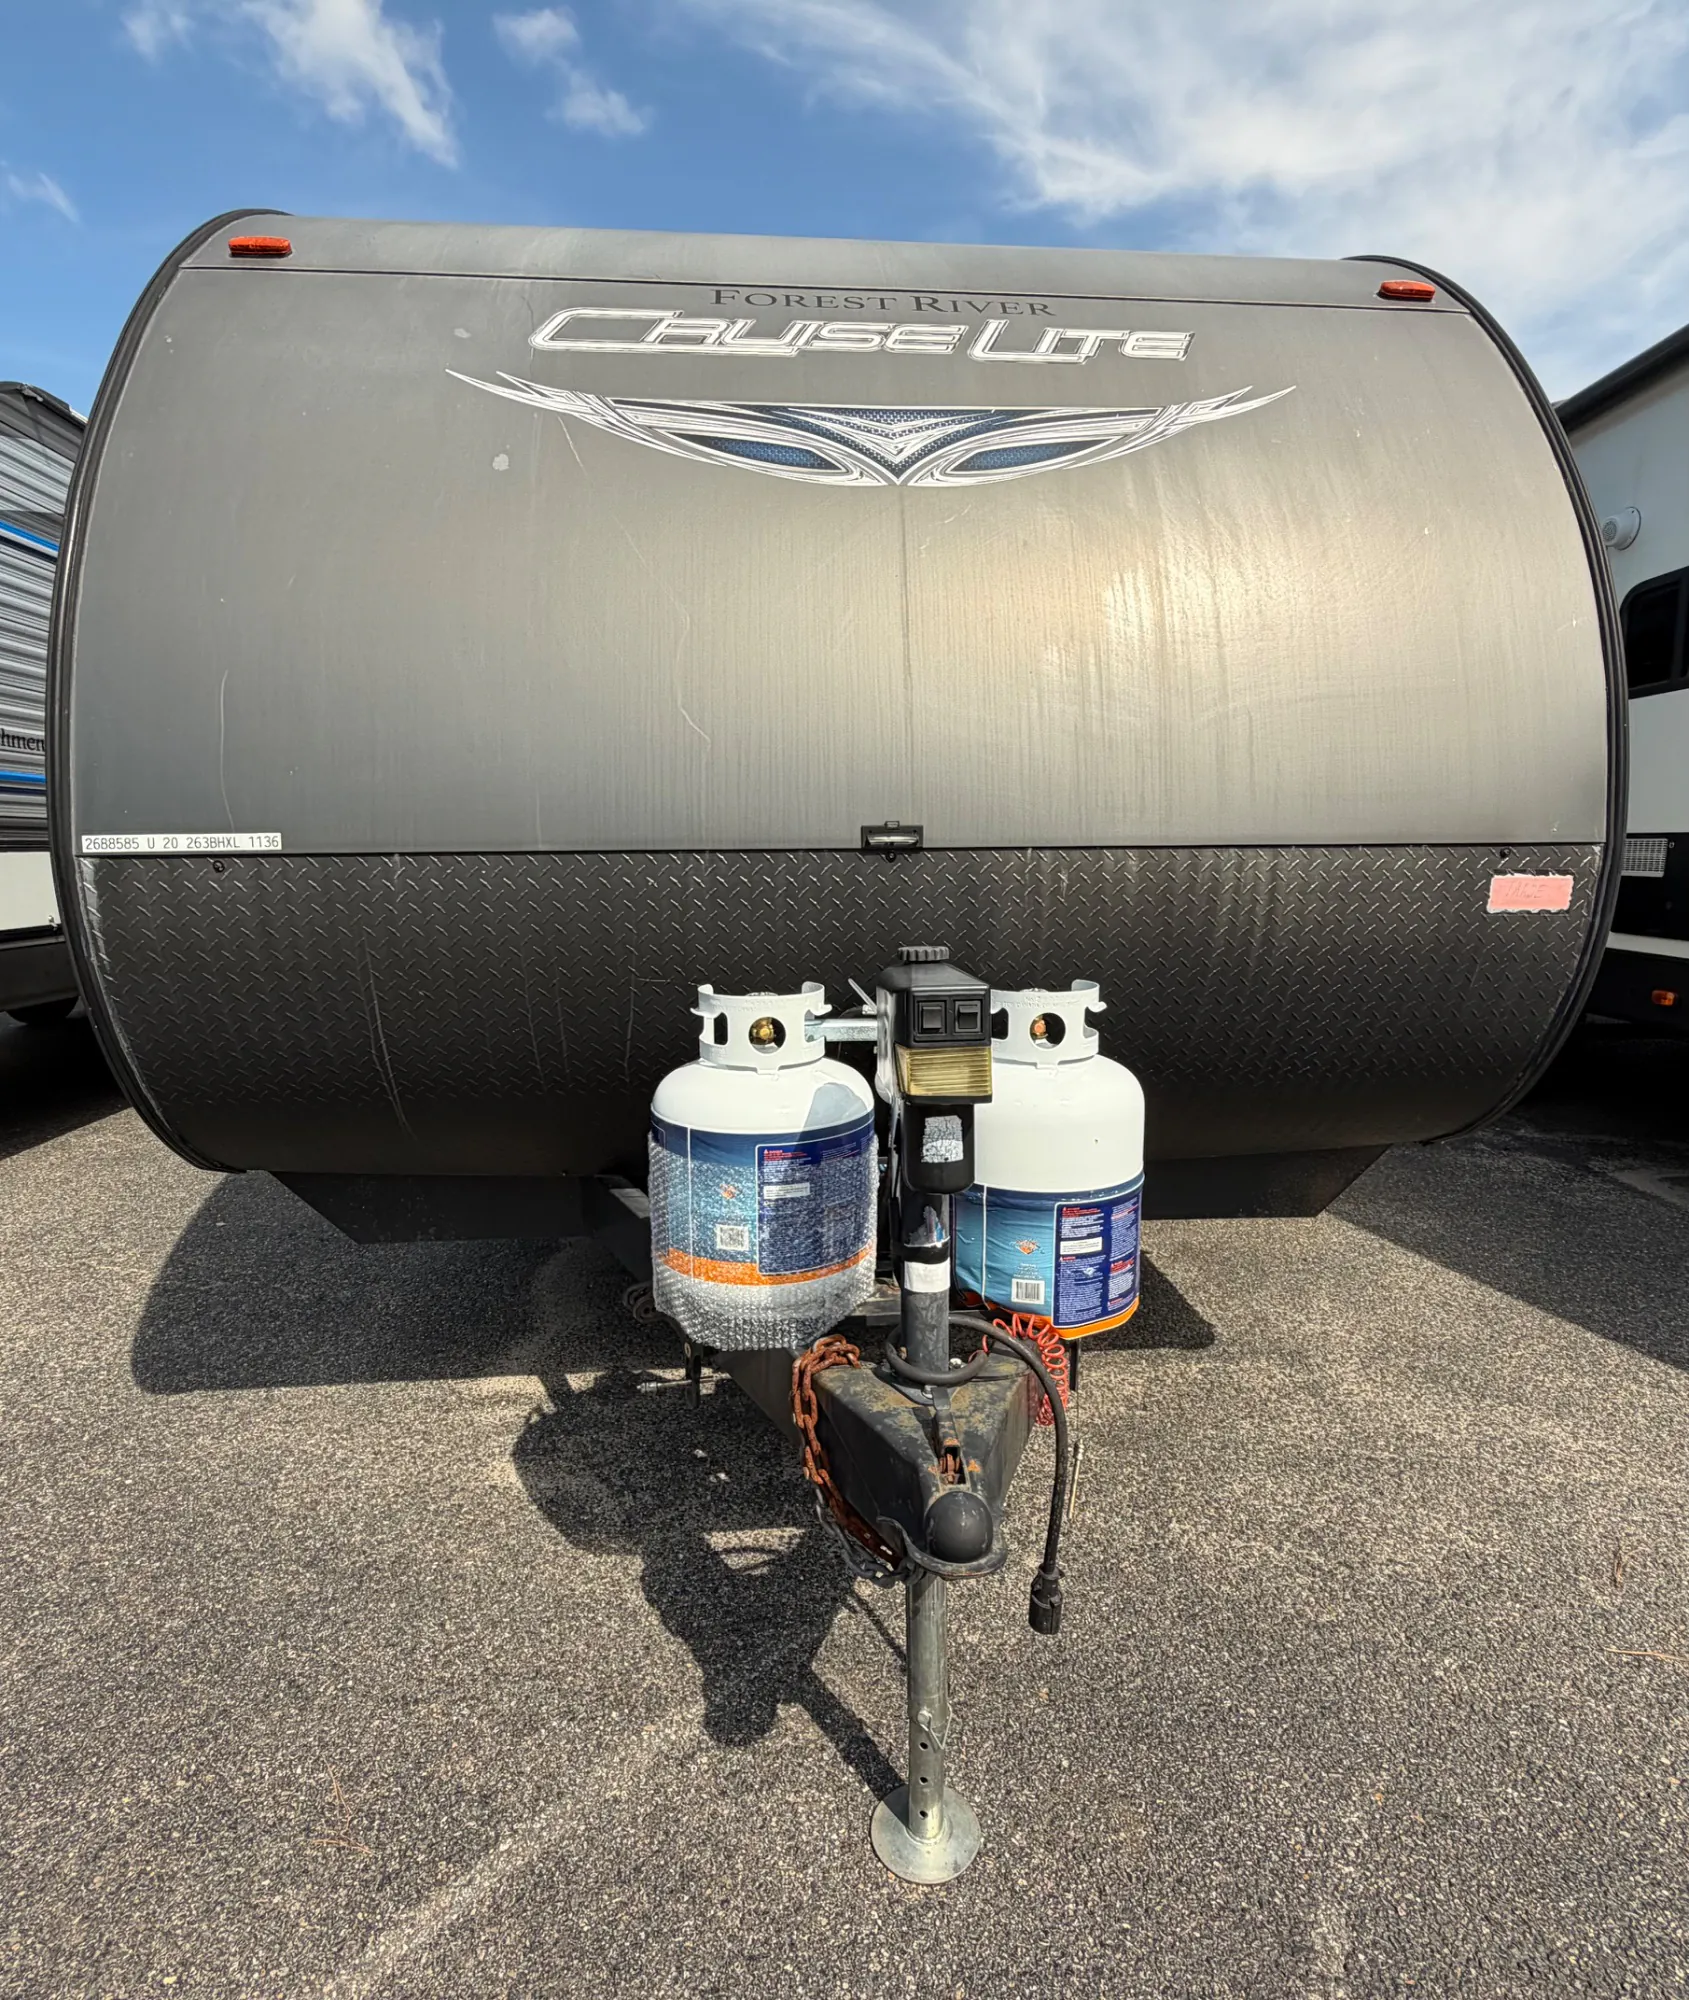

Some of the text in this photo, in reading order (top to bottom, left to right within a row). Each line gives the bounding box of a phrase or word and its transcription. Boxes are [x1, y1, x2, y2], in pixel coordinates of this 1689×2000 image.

[711, 286, 1057, 317] FOREST RIVER
[528, 305, 1196, 366] CRUISE LITE
[0, 727, 45, 753] hmen
[84, 834, 279, 851] 2688585 U 20 263BHXL 1136
